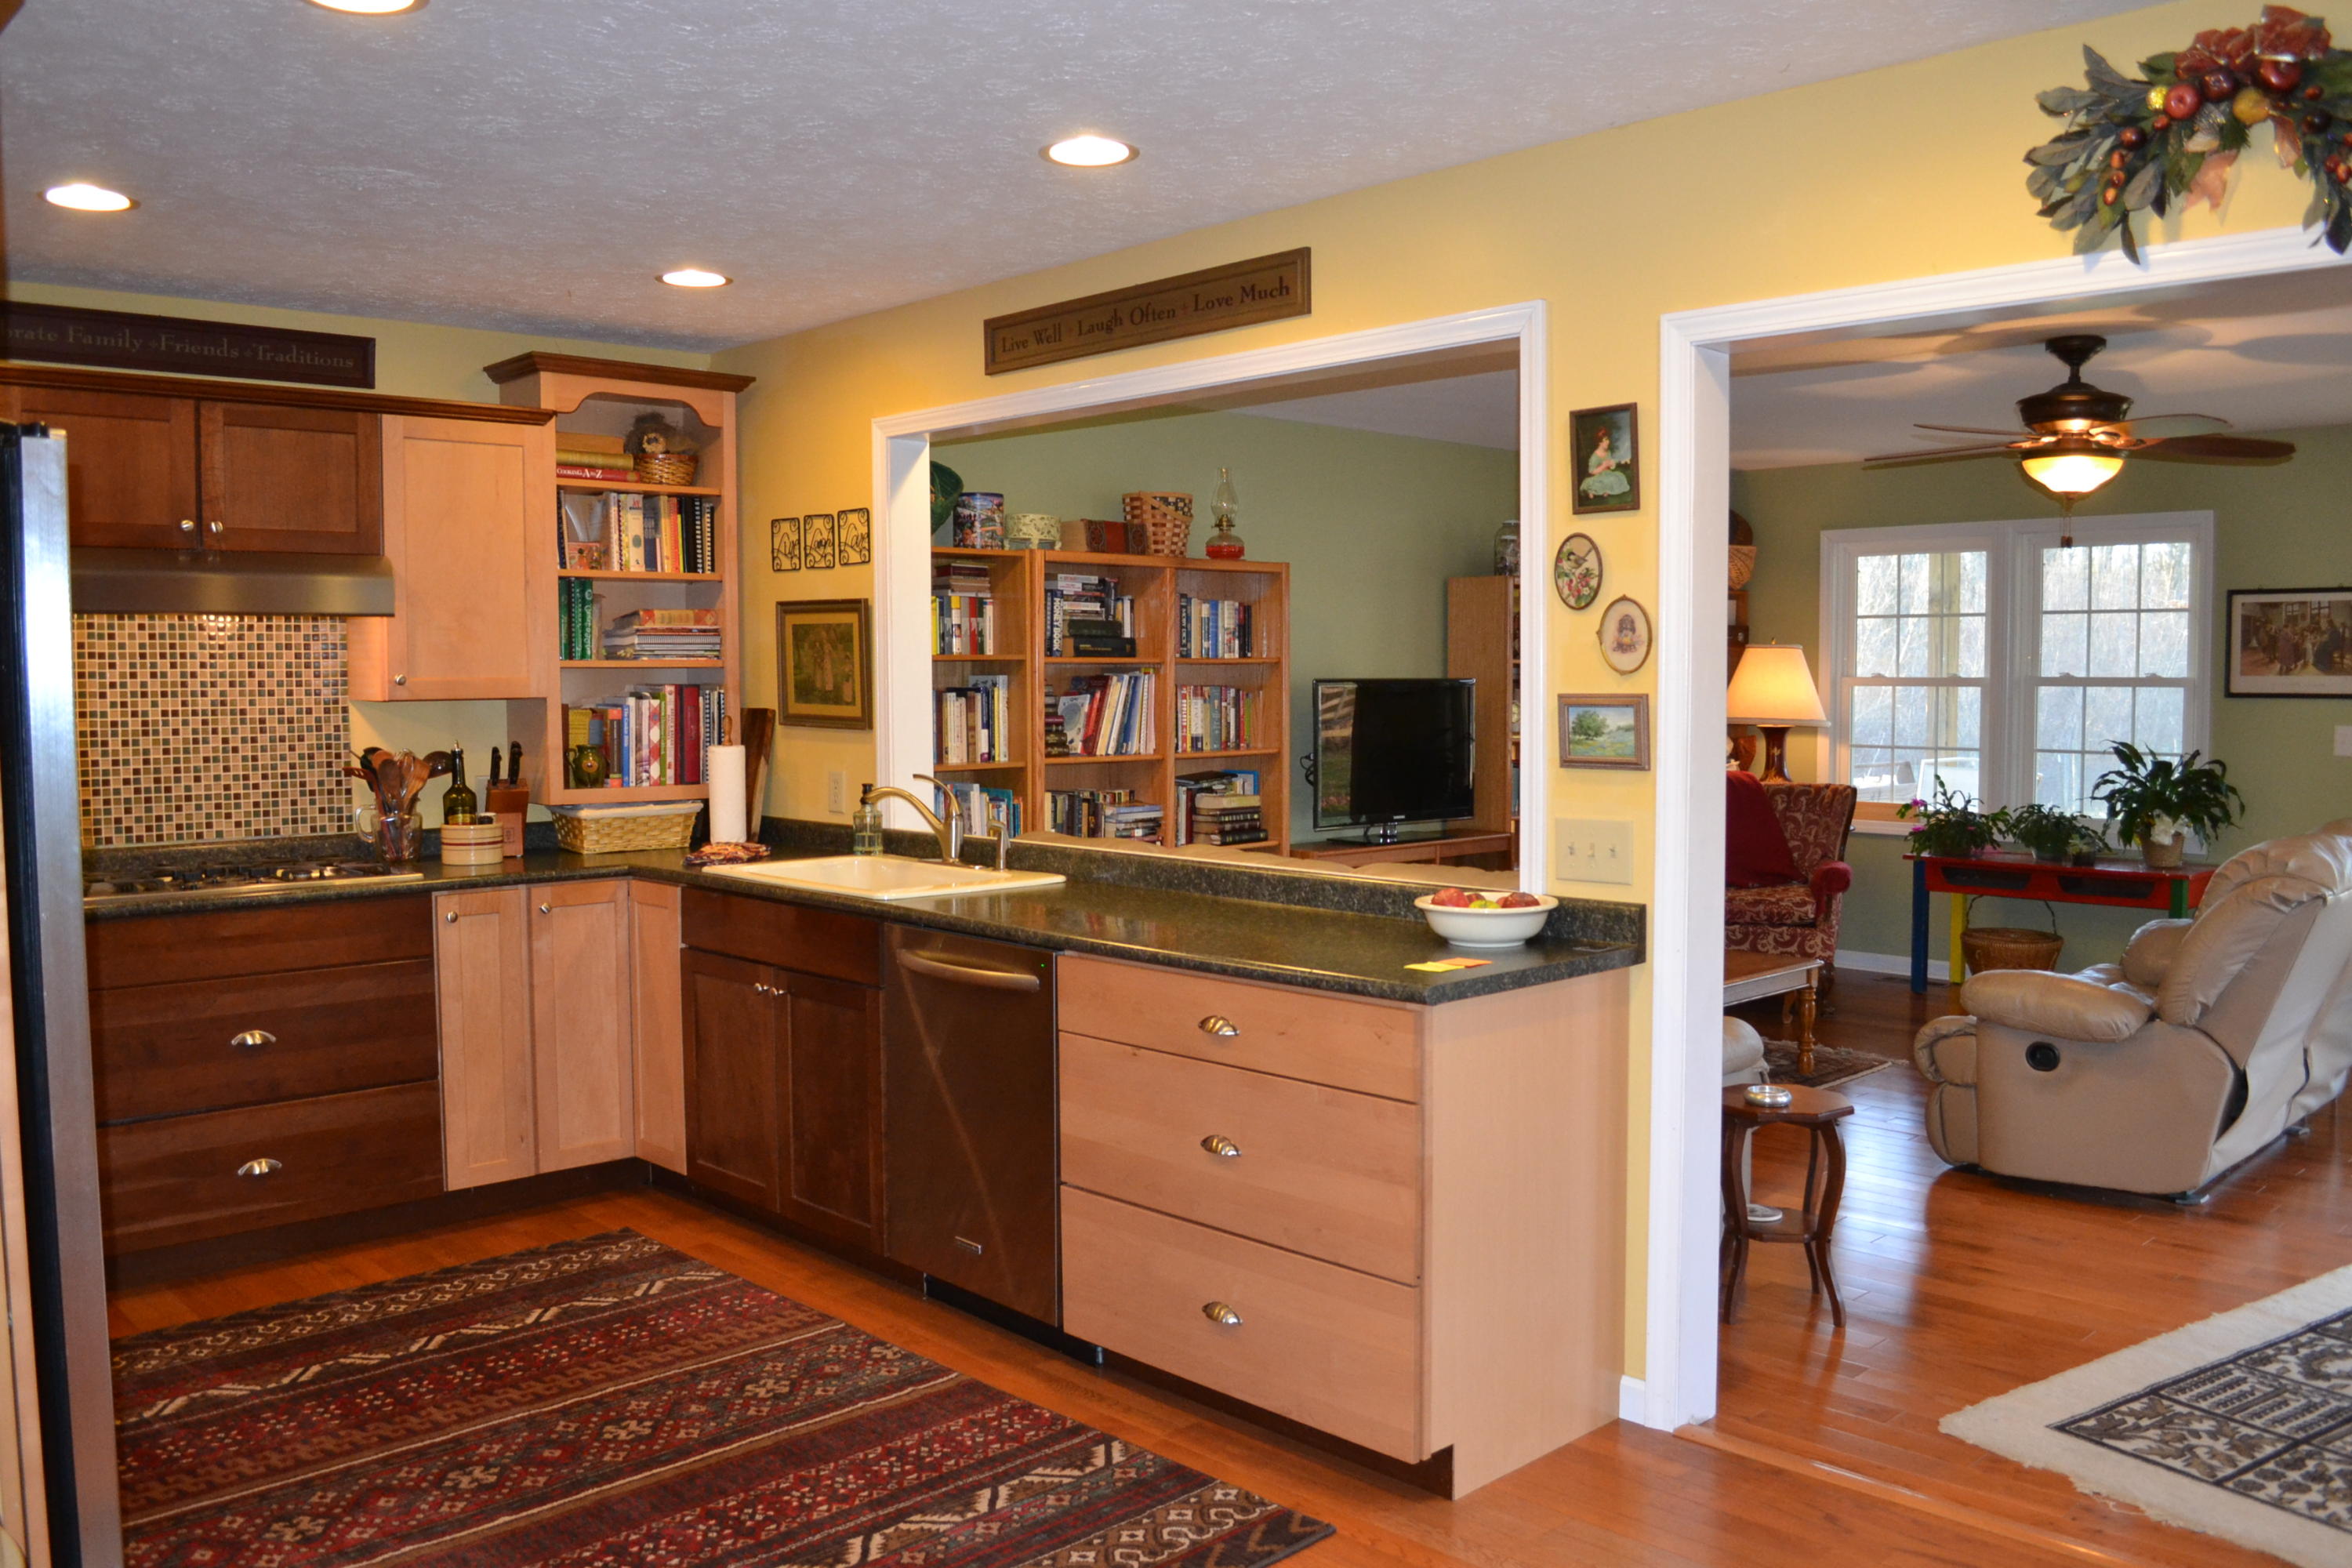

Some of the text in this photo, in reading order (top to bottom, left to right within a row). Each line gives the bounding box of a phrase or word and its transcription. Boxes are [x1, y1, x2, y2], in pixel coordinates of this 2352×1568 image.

[1001, 276, 1291, 353] Live Well Laugh Often Love Much
[67, 326, 142, 352] Family
[160, 334, 240, 359] Friends
[255, 343, 355, 369] Traditions
[583, 469, 590, 477] A
[596, 470, 602, 478] Z
